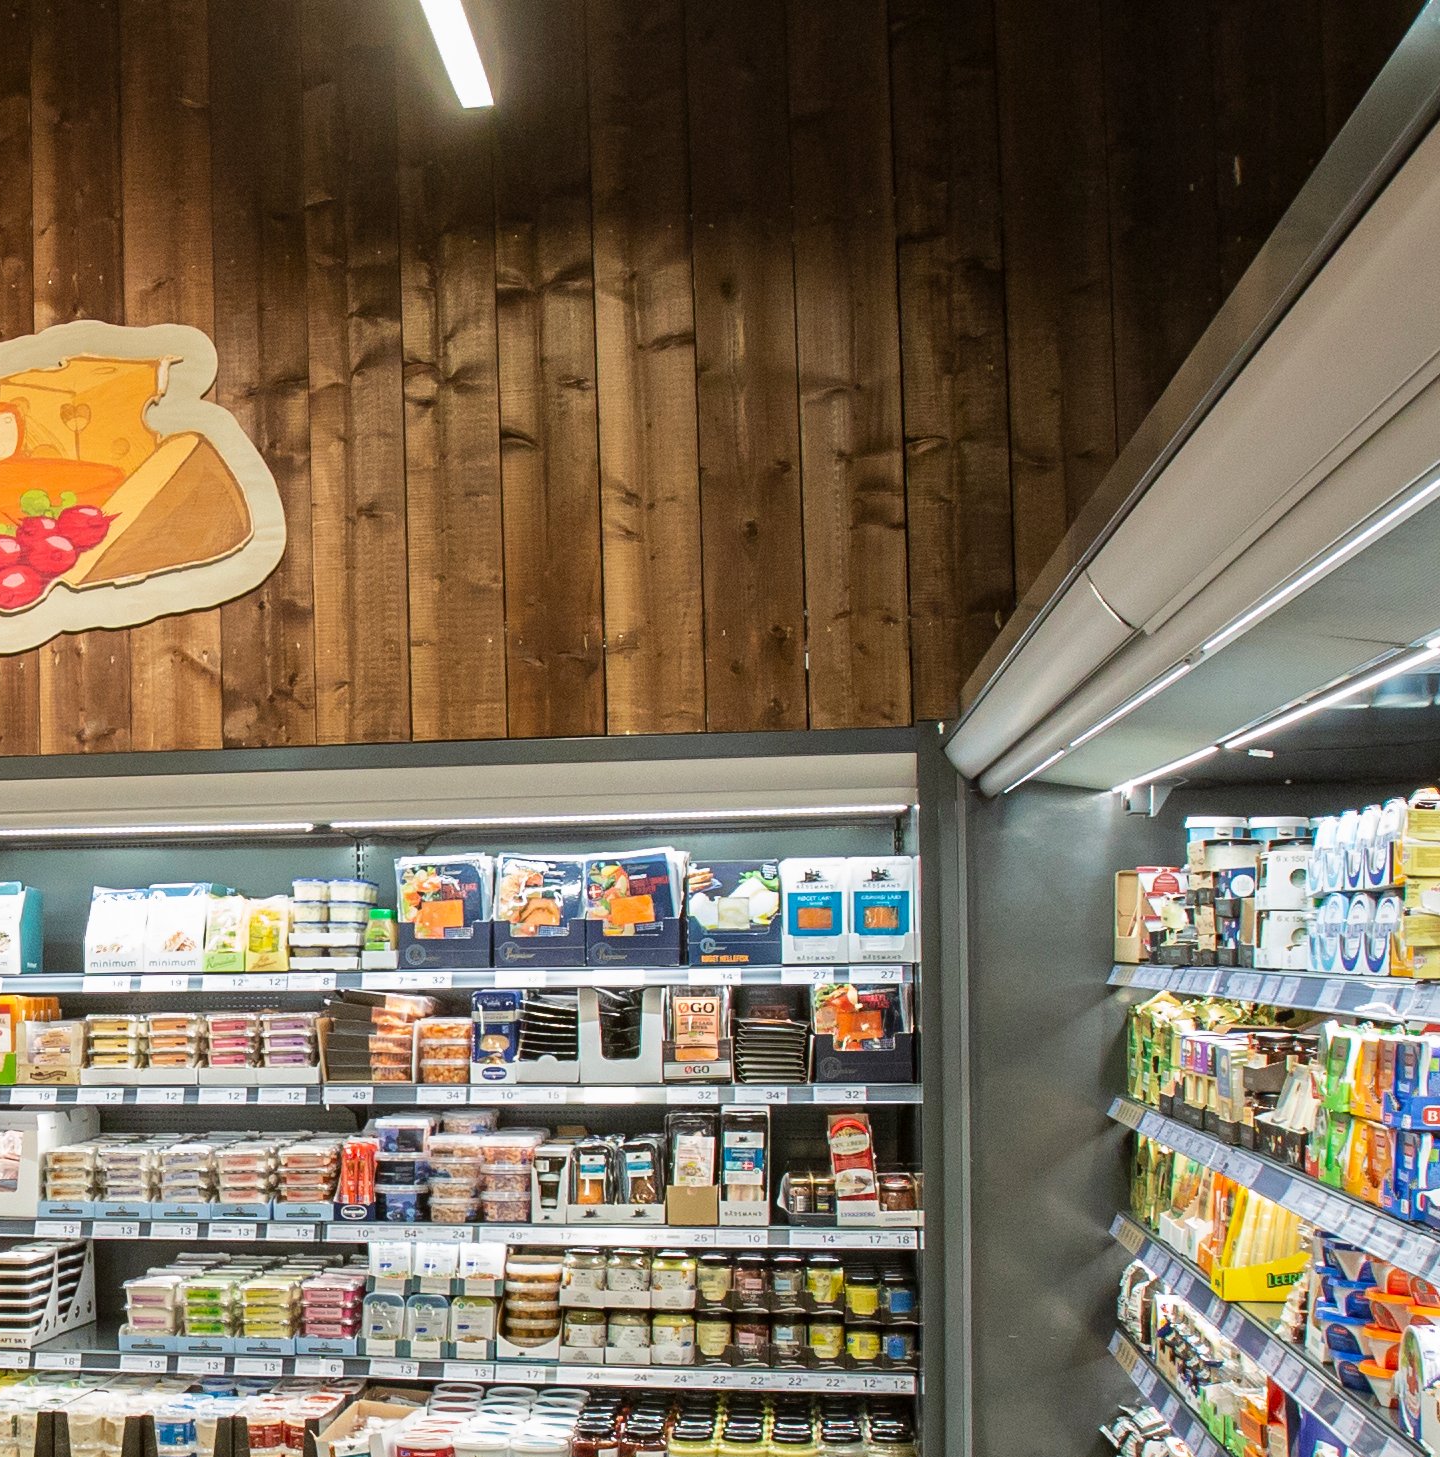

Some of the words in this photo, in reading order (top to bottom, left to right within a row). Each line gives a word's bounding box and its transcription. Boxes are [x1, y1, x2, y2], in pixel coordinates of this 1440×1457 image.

[89, 959, 137, 969] minimum
[148, 958, 197, 969] minimum
[813, 971, 826, 979] 27
[677, 1002, 715, 1014] ØGO
[685, 1064, 711, 1074] ØGO
[766, 1091, 780, 1099] 34
[845, 1091, 859, 1099] 32
[452, 1231, 465, 1239] 24
[822, 1235, 835, 1243] 14
[63, 1357, 75, 1365] 18
[526, 1370, 539, 1378] 17
[788, 1377, 802, 1385] 22
